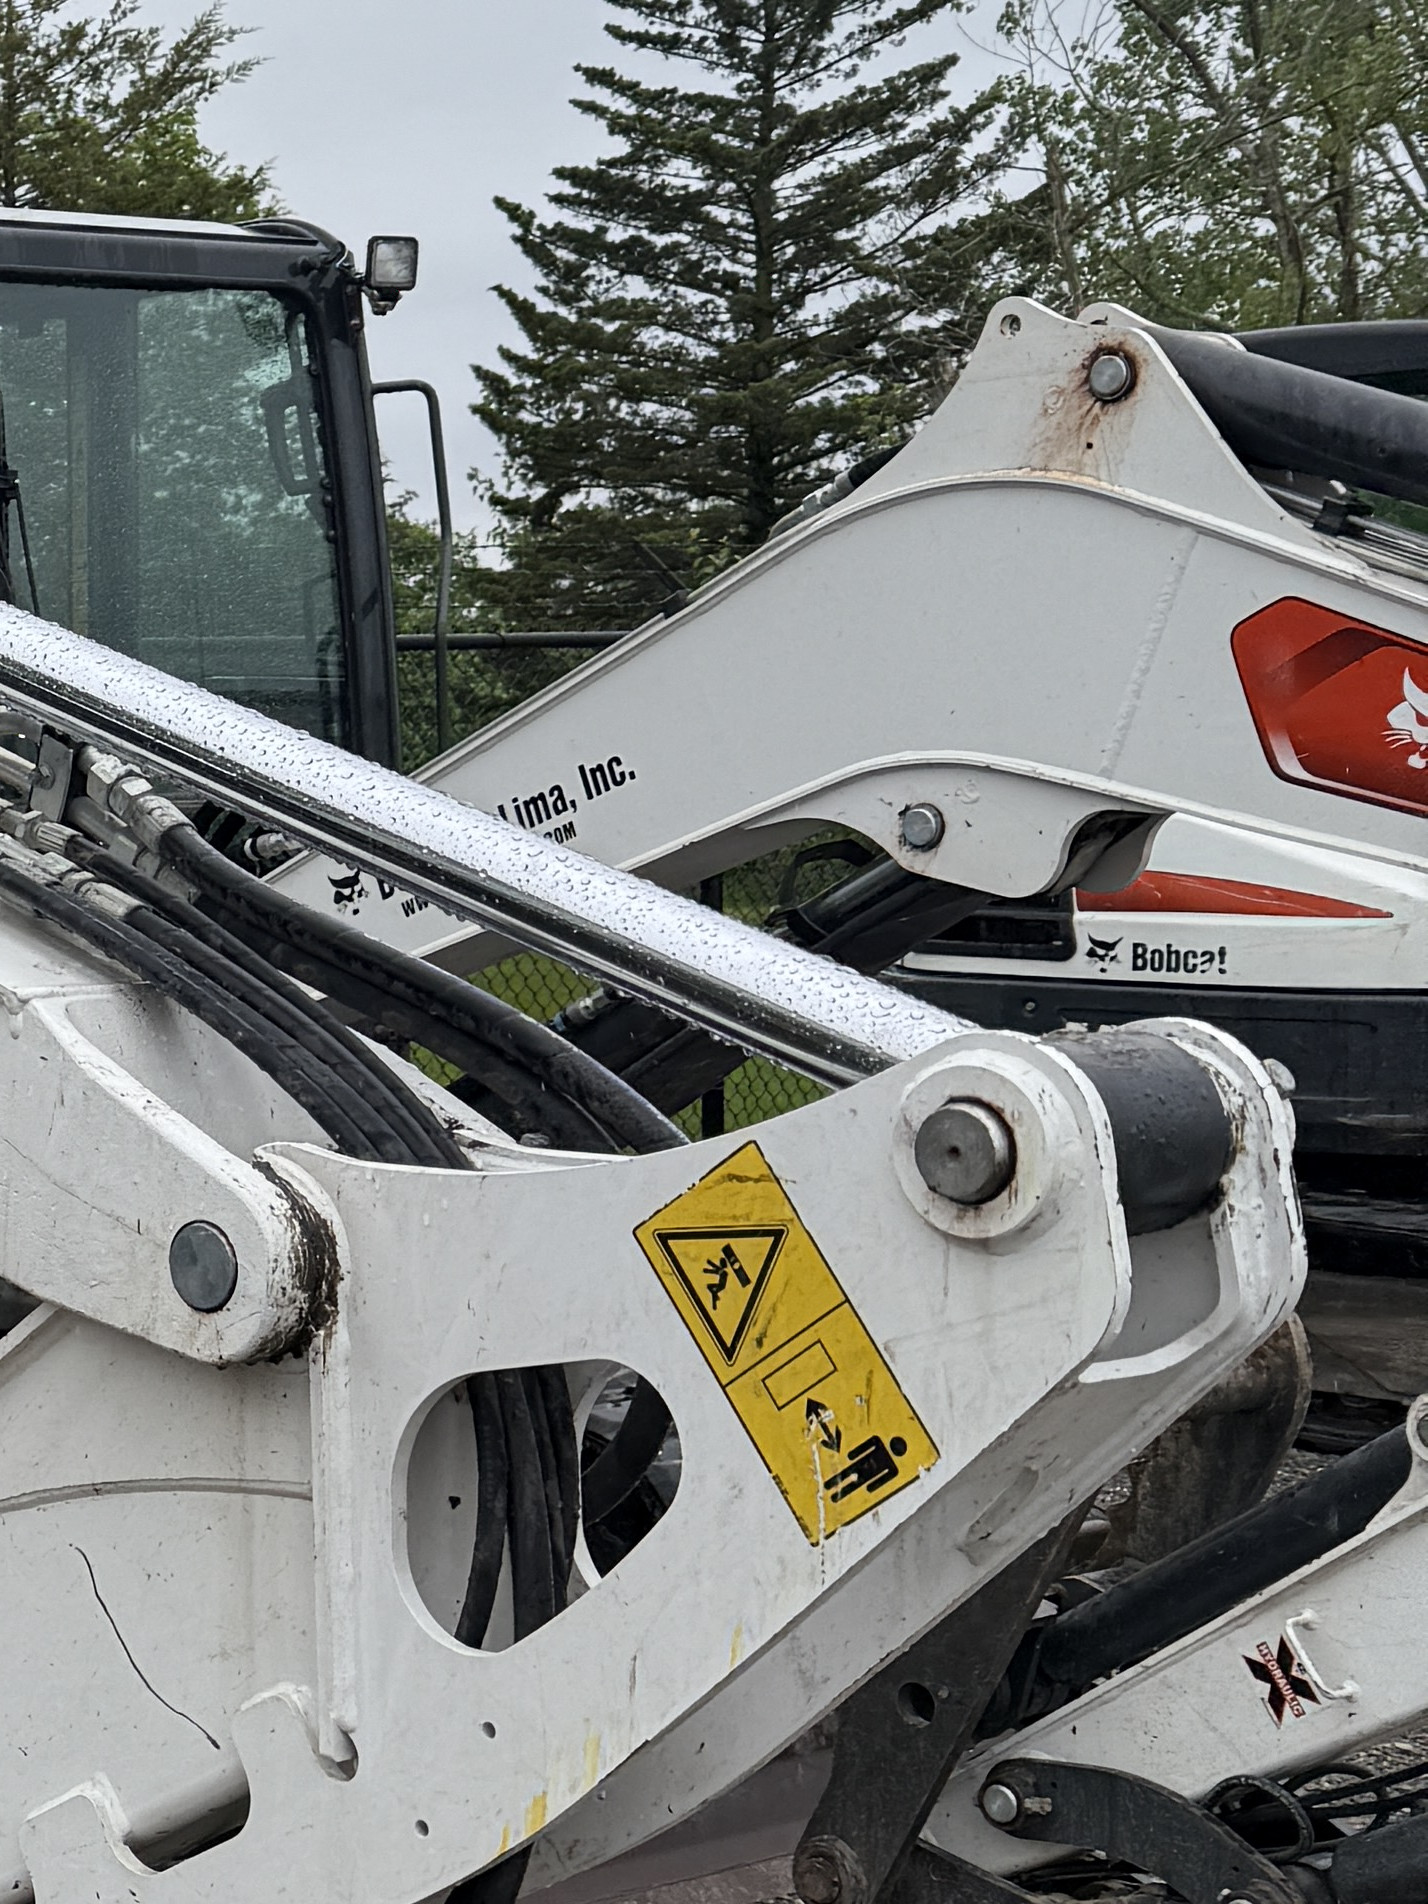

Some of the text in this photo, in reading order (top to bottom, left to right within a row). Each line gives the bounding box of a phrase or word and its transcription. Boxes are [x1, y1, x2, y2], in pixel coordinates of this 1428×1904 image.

[578, 755, 636, 800] Inc.
[1131, 942, 1227, 974] Bobcat
[1257, 1643, 1304, 1717] HYDRAULIC
